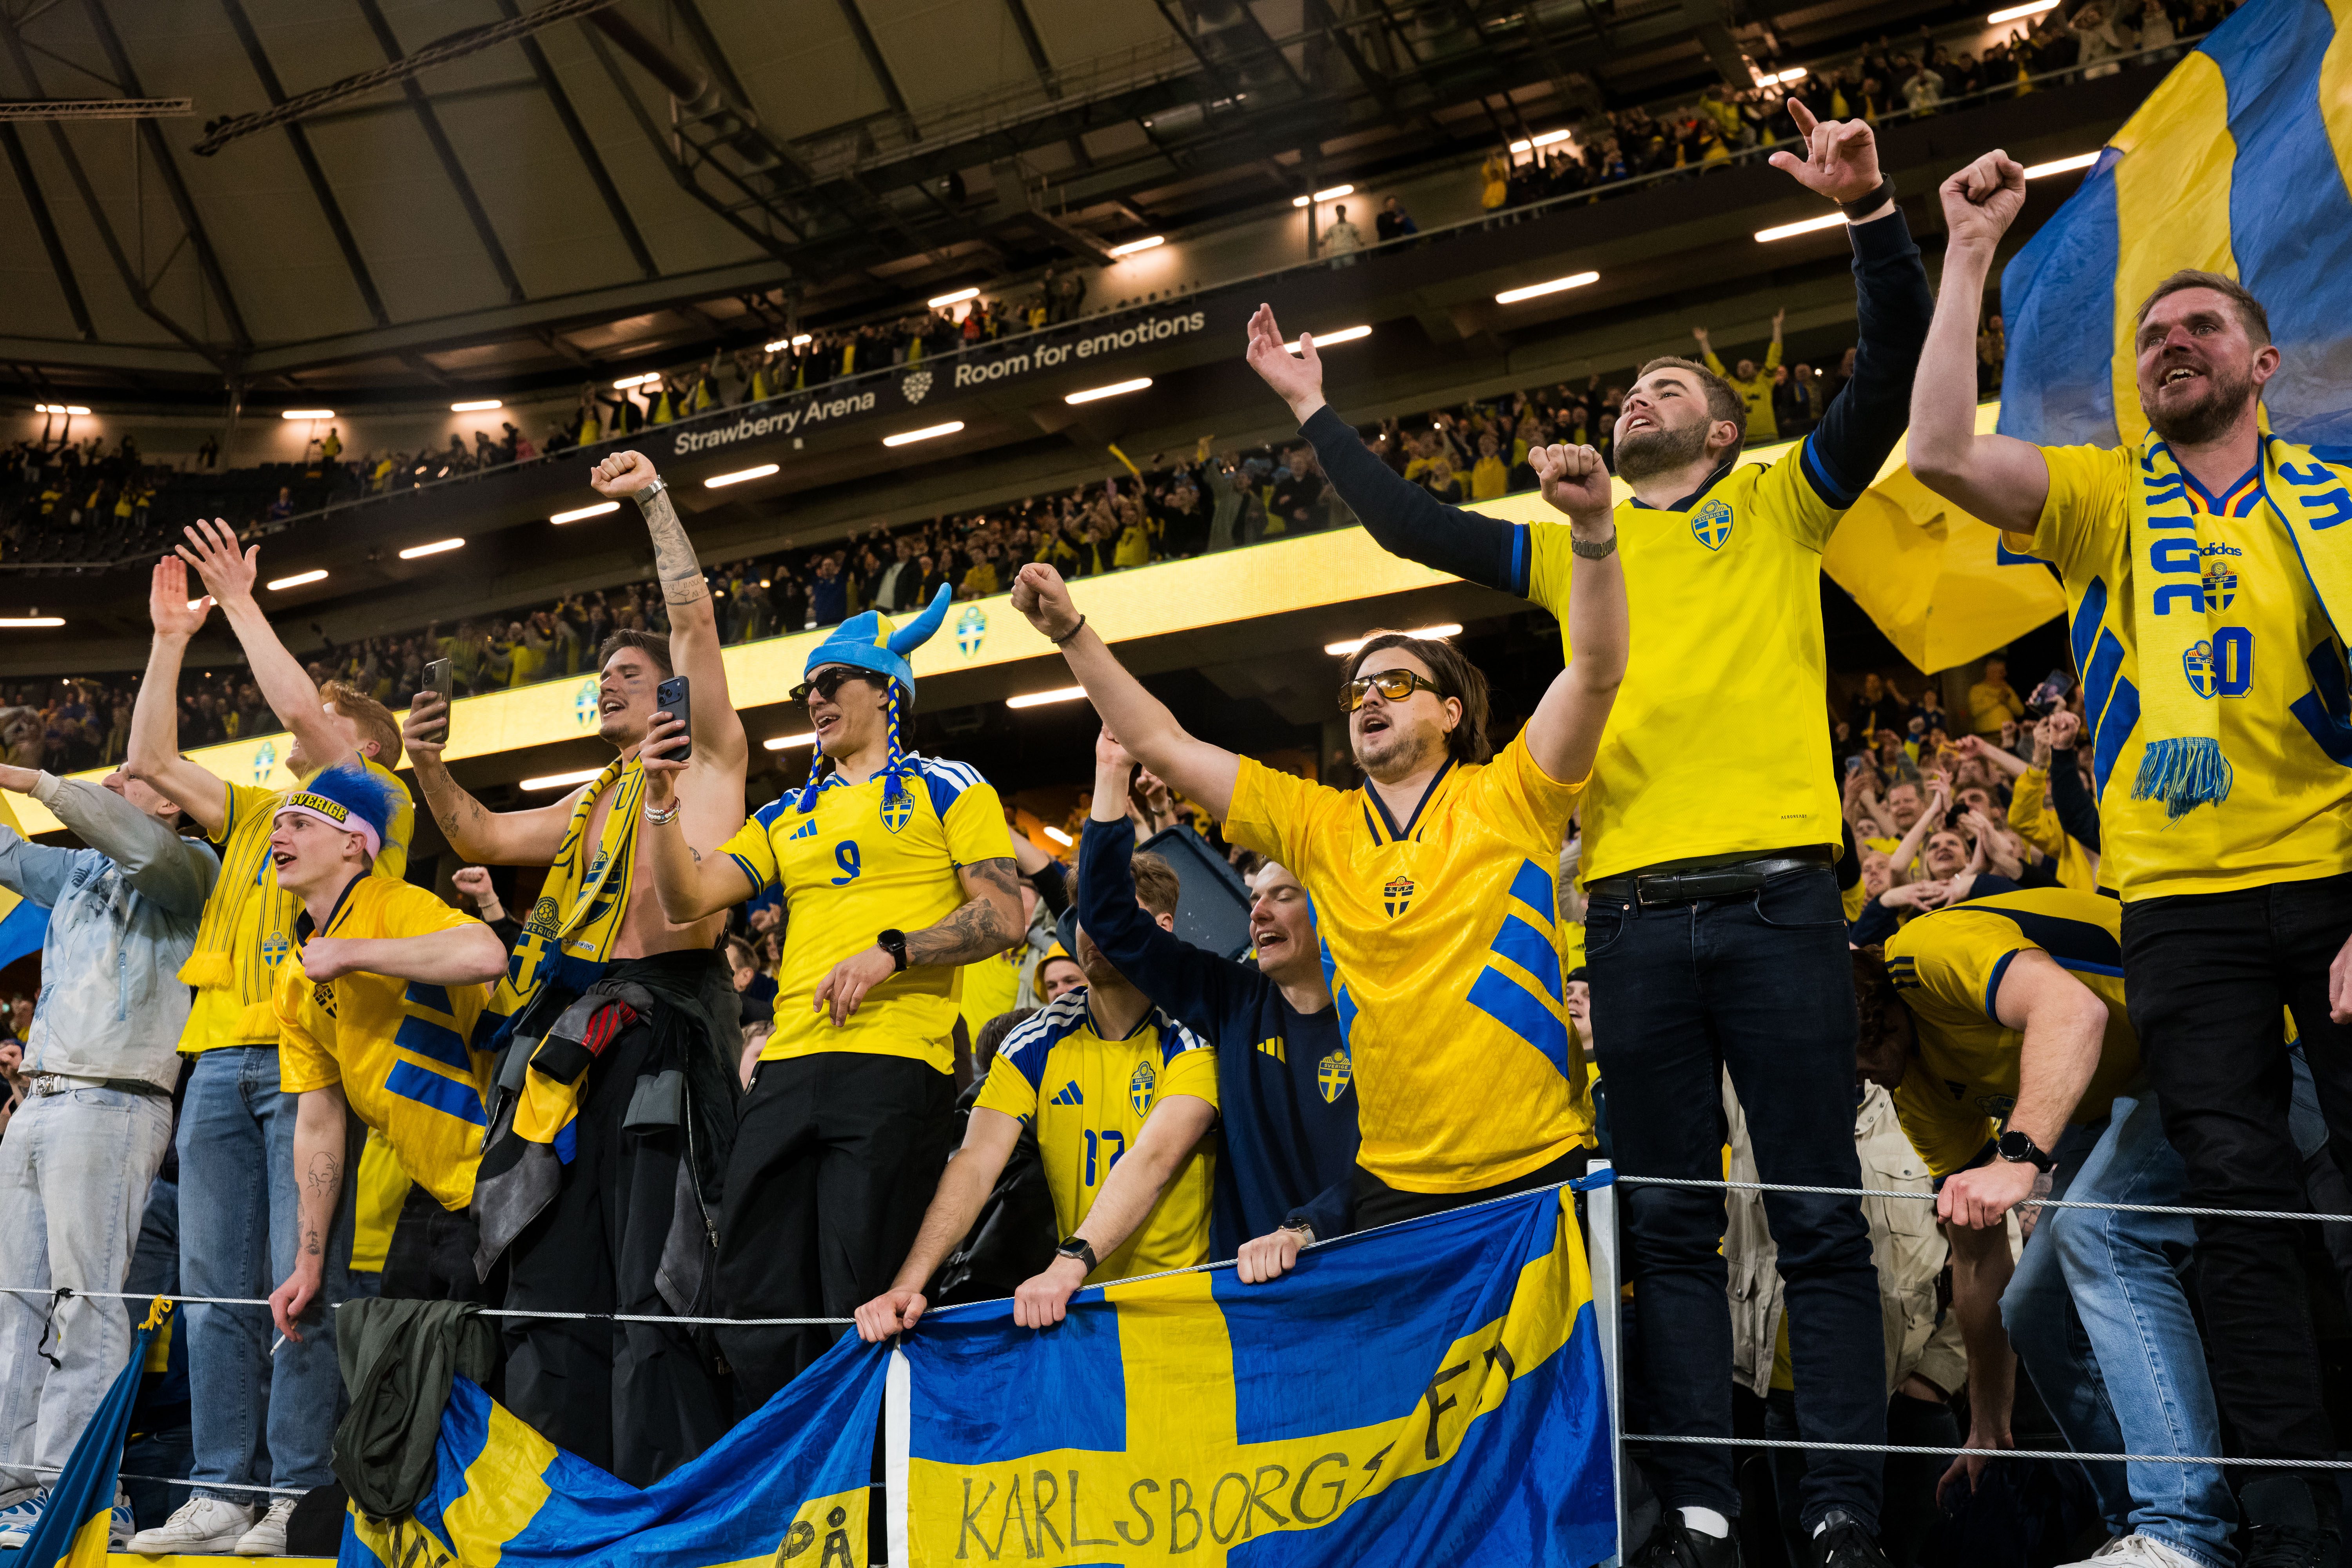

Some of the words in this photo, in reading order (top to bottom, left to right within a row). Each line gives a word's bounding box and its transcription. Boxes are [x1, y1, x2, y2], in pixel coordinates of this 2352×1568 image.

[955, 353, 1029, 388] Room
[1034, 342, 1073, 368] for
[1076, 312, 1205, 358] emotions
[674, 409, 801, 455] Strawberry
[803, 392, 876, 425] Arena
[1698, 511, 1725, 522] SVERIGE
[289, 793, 350, 824] SVERIGE
[831, 840, 861, 886] 9
[526, 923, 557, 940] VERIGE
[775, 1506, 855, 1568] PÅ
